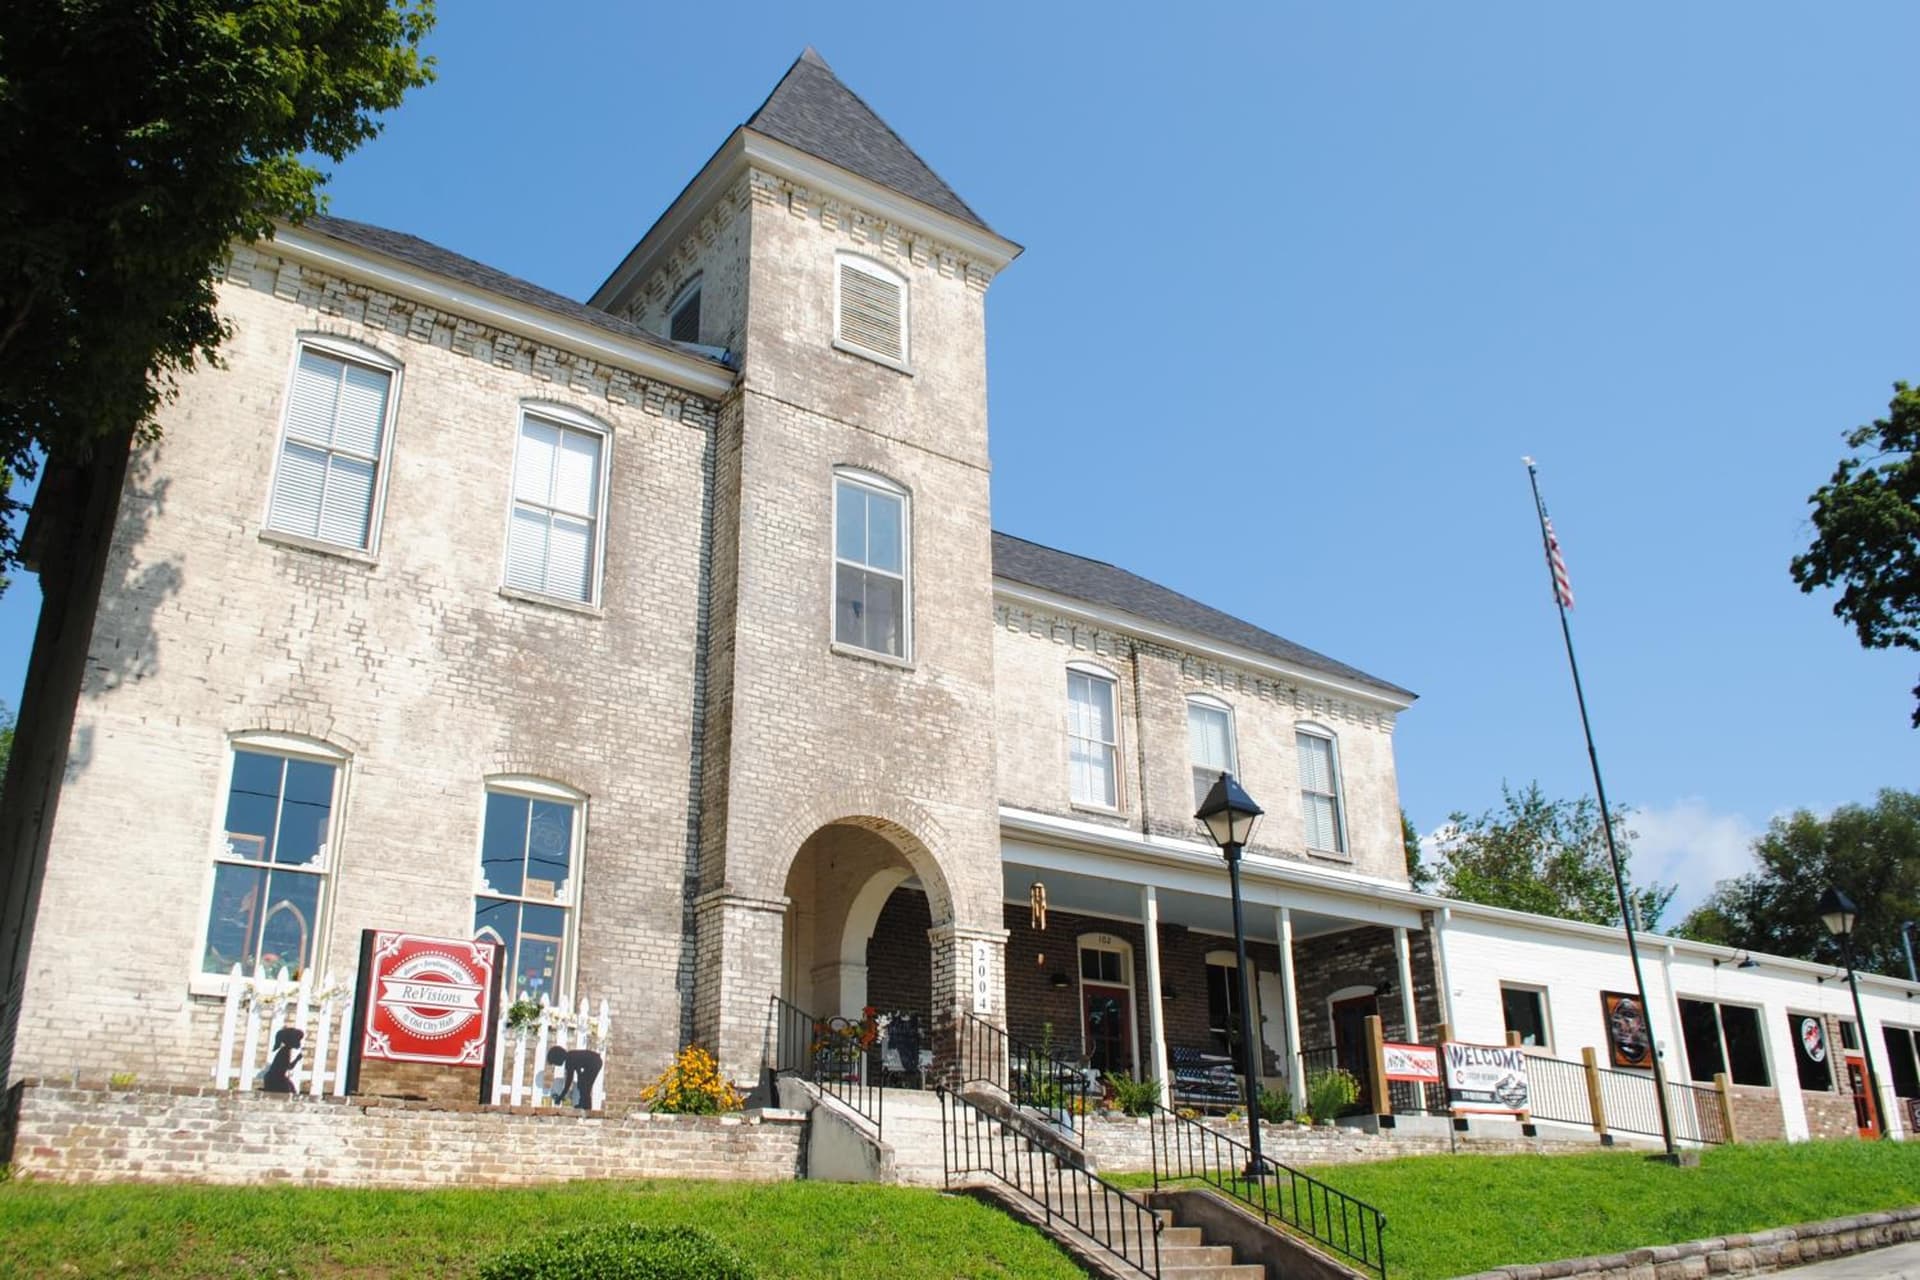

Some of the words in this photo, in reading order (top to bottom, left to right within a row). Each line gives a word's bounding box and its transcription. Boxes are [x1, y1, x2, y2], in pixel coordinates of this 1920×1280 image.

[978, 948, 987, 1009] 2004
[402, 985, 462, 1004] ReVisions
[409, 1016, 423, 1029] Old
[423, 1021, 438, 1033] City
[439, 1016, 454, 1030] Hall
[1446, 1044, 1525, 1072] WELCOME
